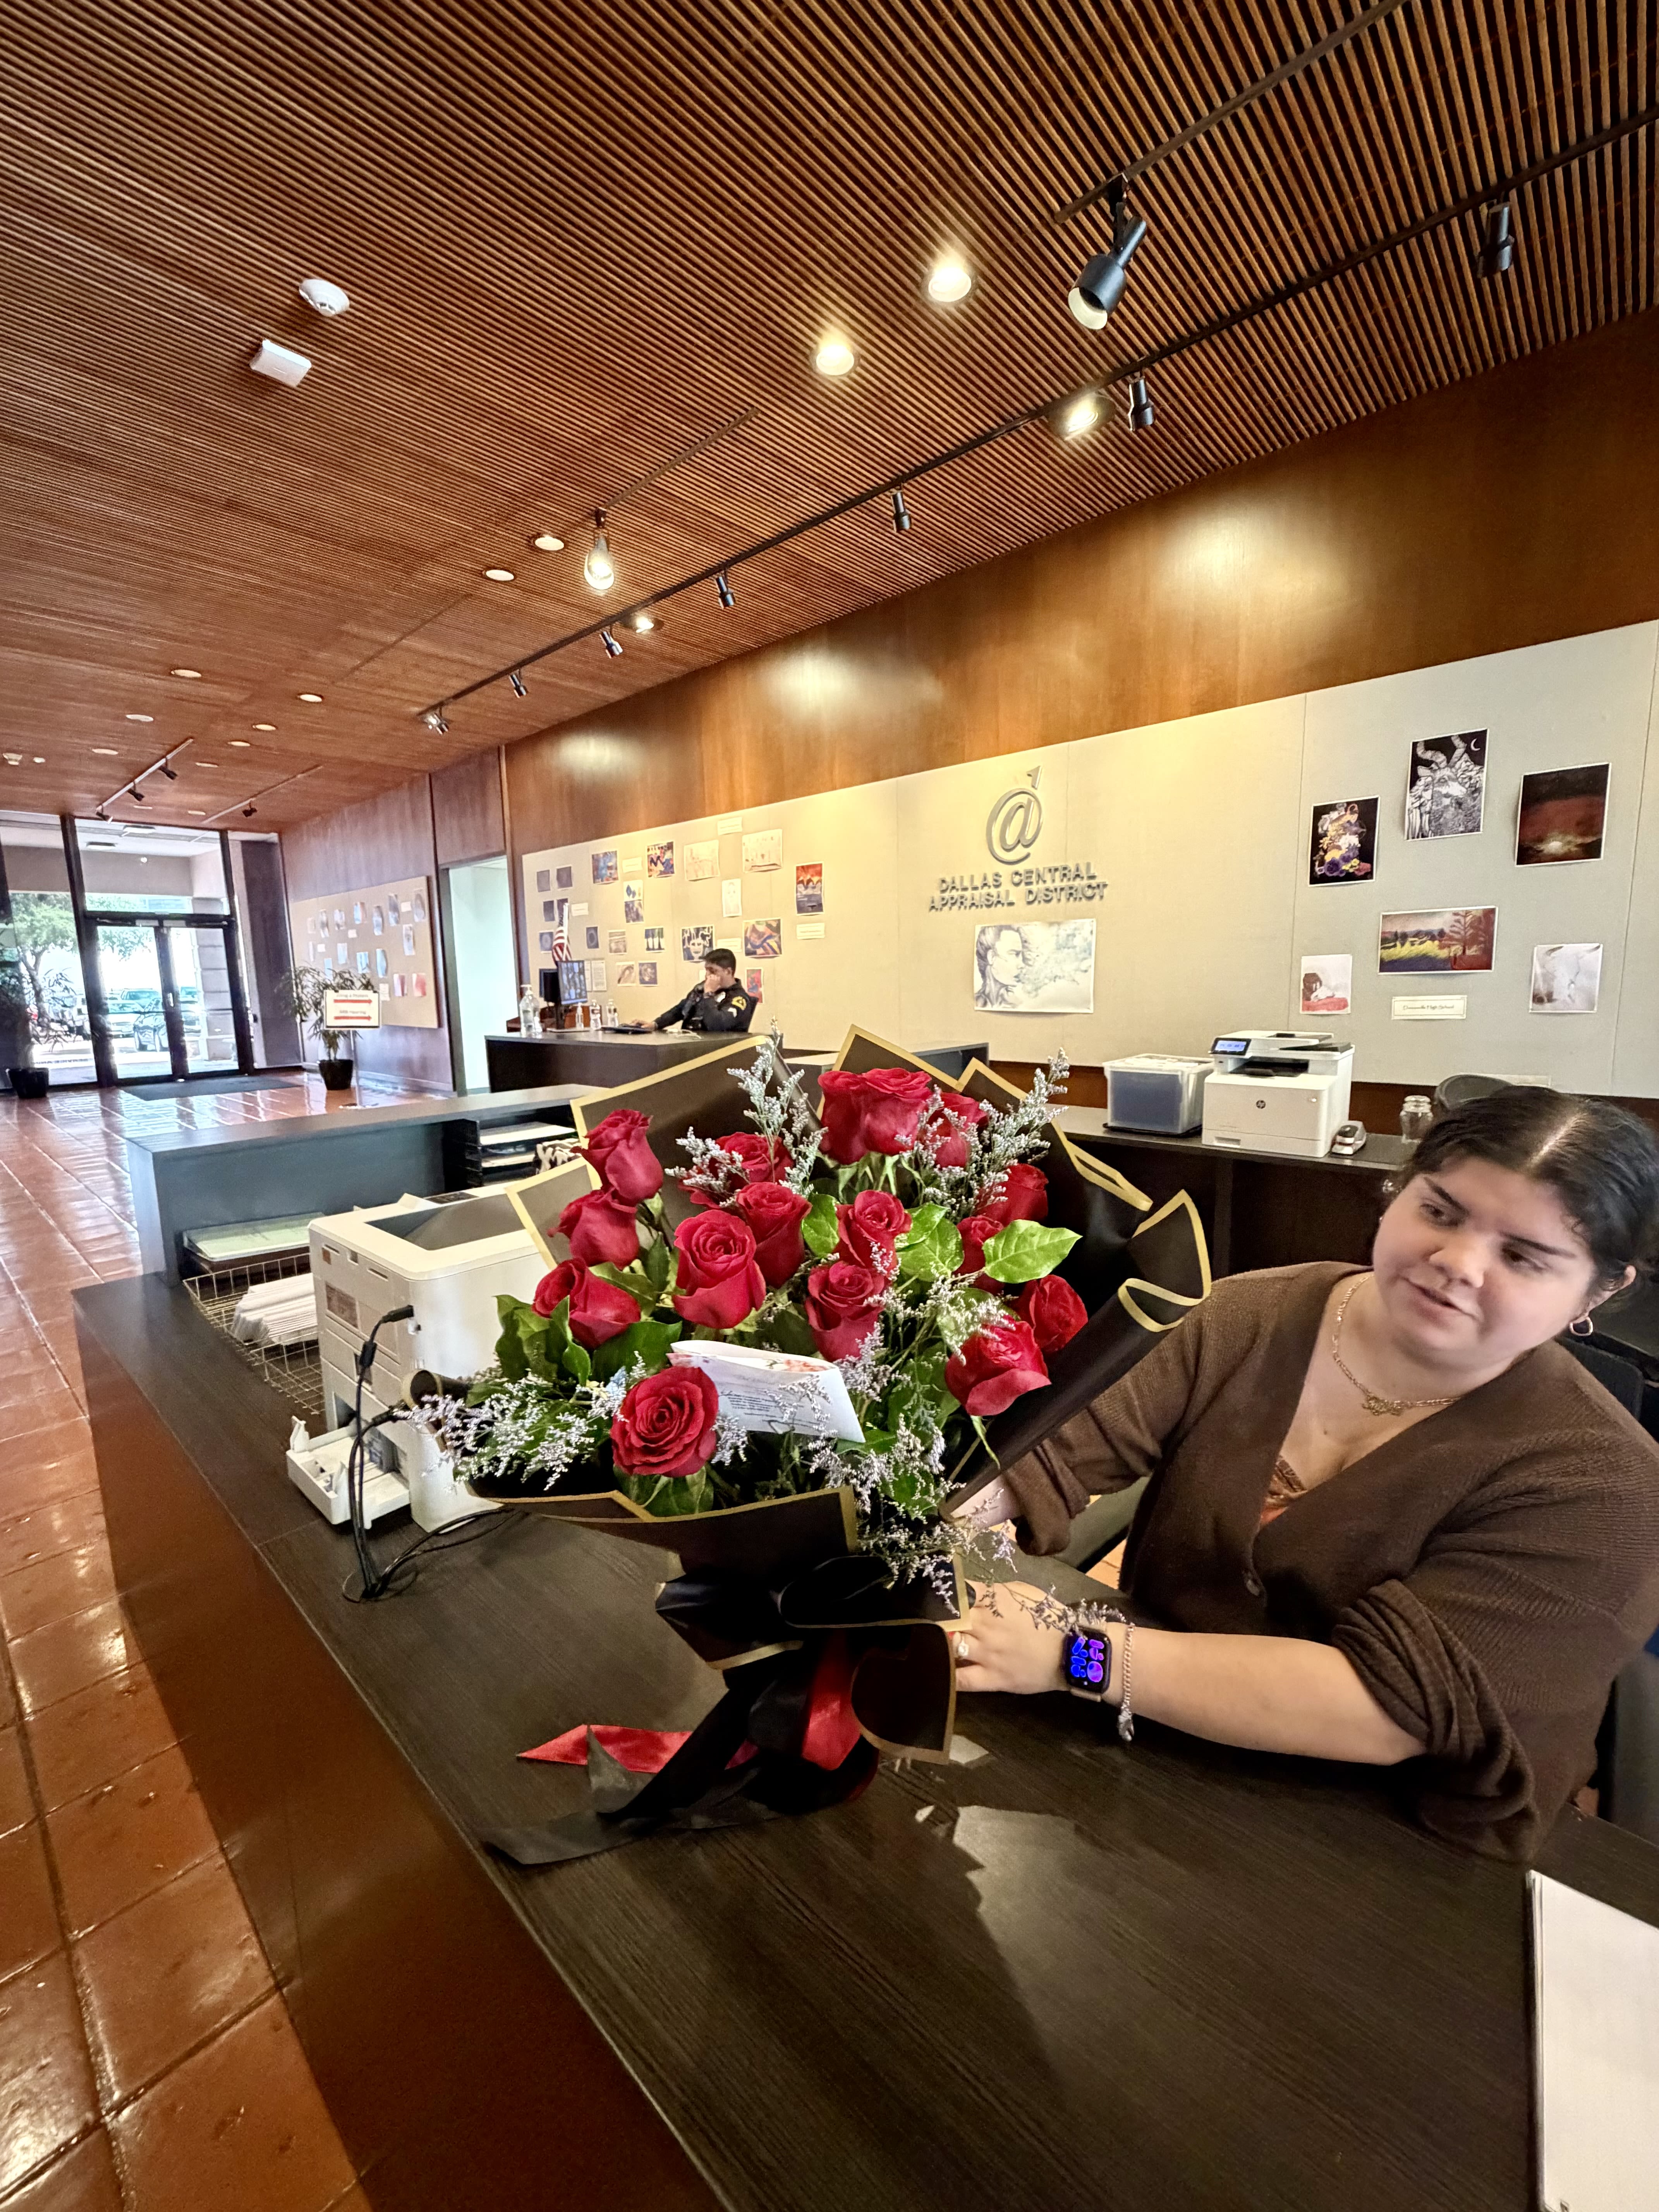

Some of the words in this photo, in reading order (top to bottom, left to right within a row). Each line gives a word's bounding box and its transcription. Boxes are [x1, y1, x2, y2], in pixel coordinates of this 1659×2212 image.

[938, 871, 1002, 893] DALLAS
[1011, 862, 1097, 886] CENTRAL
[929, 890, 1015, 912] APPRAISAL
[1025, 881, 1108, 905] DISTRICT
